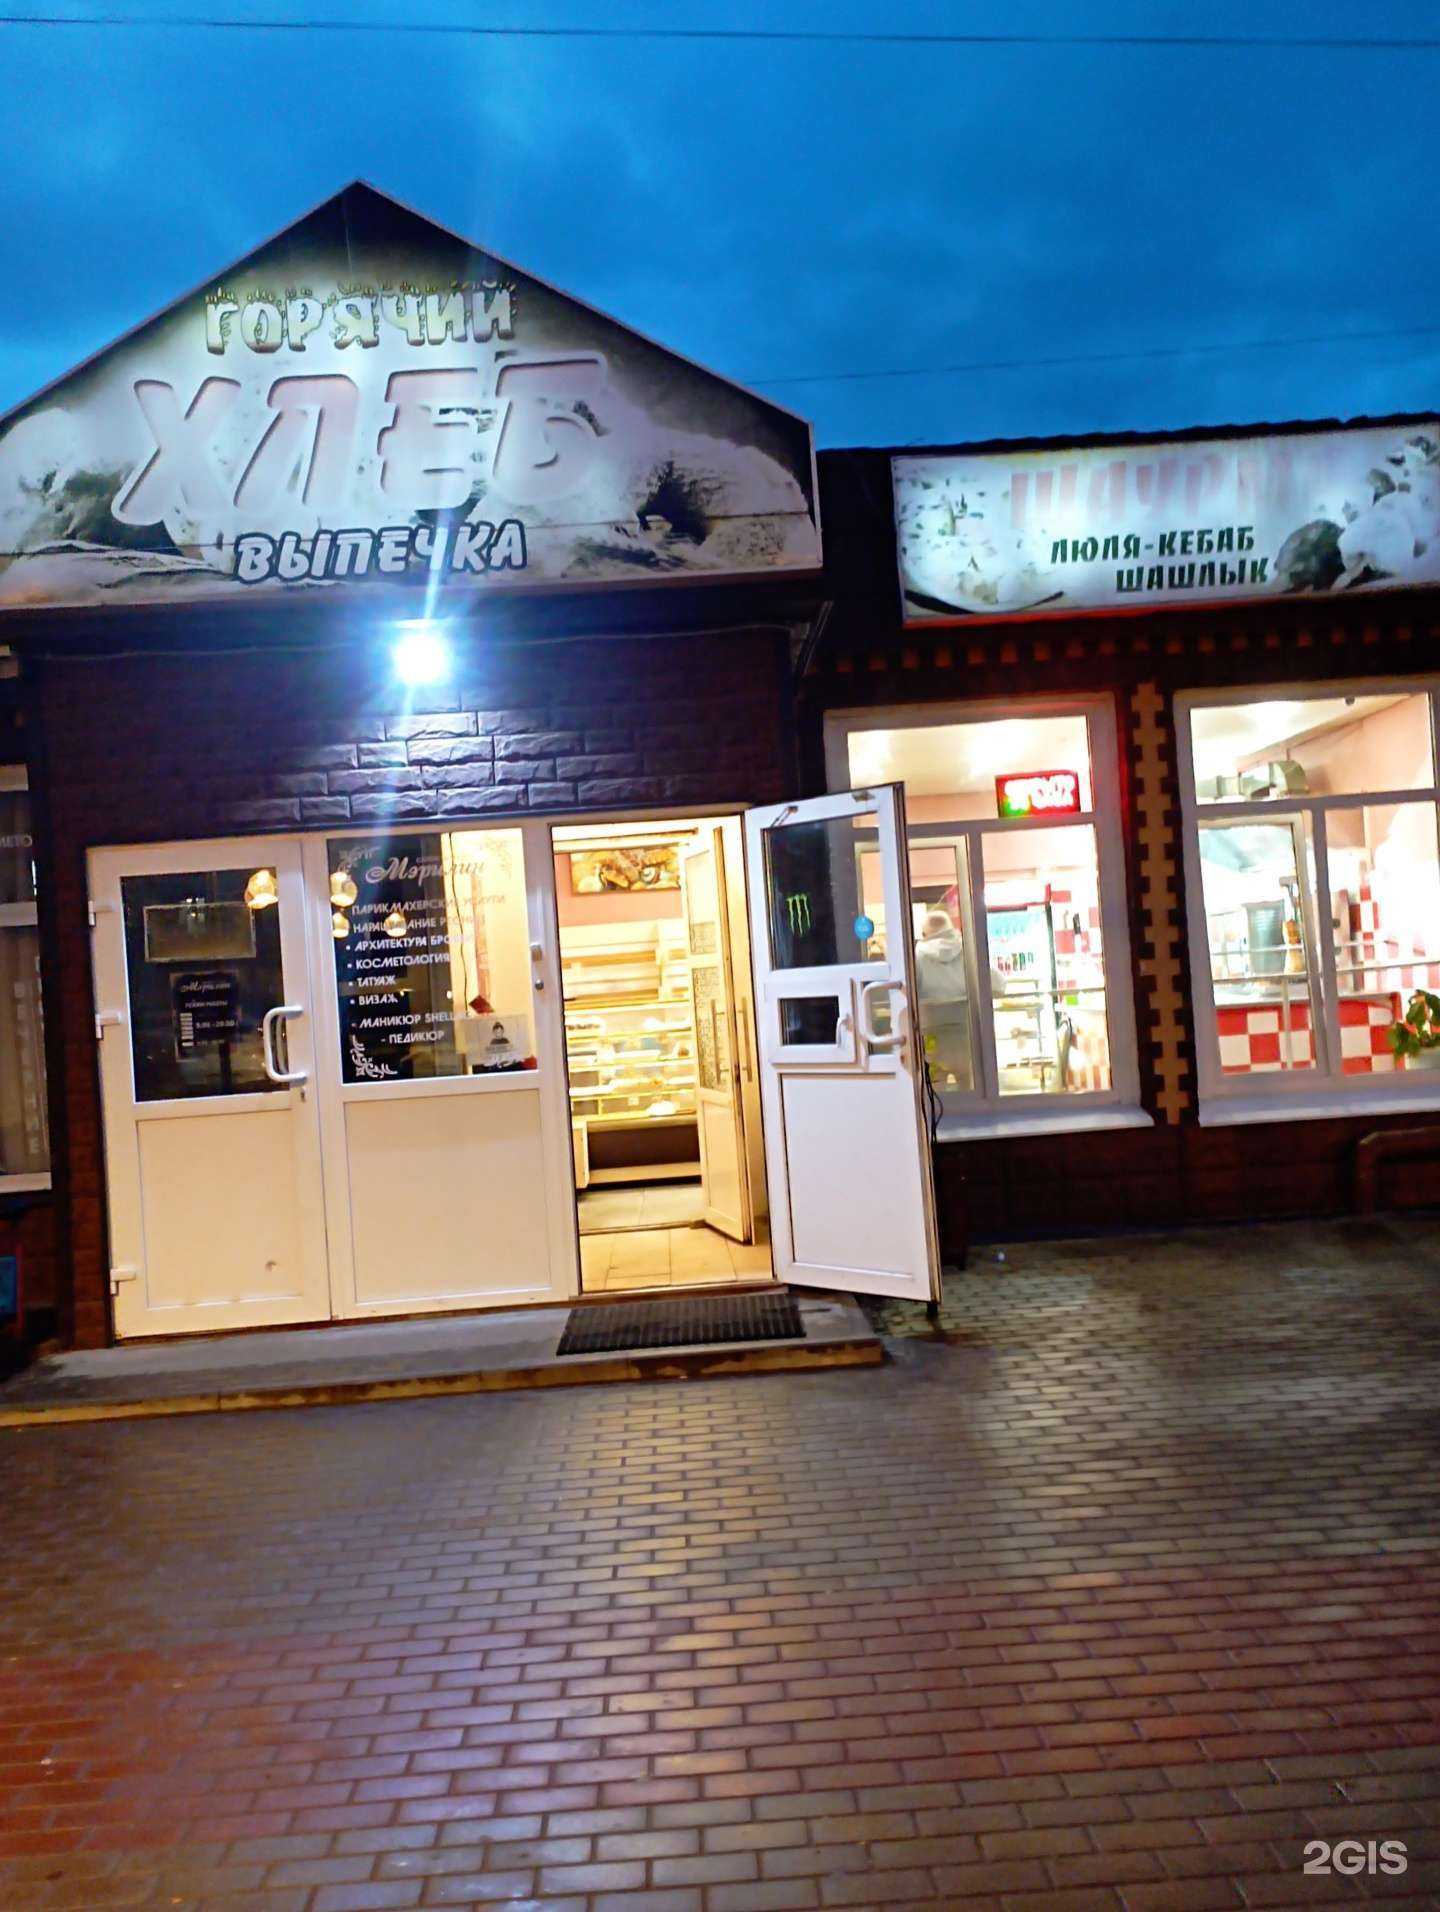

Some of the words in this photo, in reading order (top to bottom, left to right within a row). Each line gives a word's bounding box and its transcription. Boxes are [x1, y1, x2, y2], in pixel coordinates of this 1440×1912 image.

[205, 281, 517, 355] ГОРЯЧИЙ
[111, 353, 607, 525] ХЛЕБ
[1010, 443, 1303, 529] ШАУРМ
[233, 519, 527, 584] ВЫПЕЧКА
[1050, 525, 1255, 565] ЛЮЛЯ-КЕБАБ
[1116, 557, 1269, 593] ШАШЛЫК
[353, 918, 437, 934] НАРААНИЕ
[355, 937, 427, 952] АРХИТЕКТУРА
[355, 953, 450, 970] КОСМЕТОЛОГИЯ
[357, 975, 396, 988] ТАТУАЖ
[358, 994, 398, 1006] ВИЗАЖ
[360, 1015, 421, 1029] МАНИКЮР
[425, 1012, 471, 1023] SHELL
[388, 1030, 445, 1044] ПЕДИКЮР
